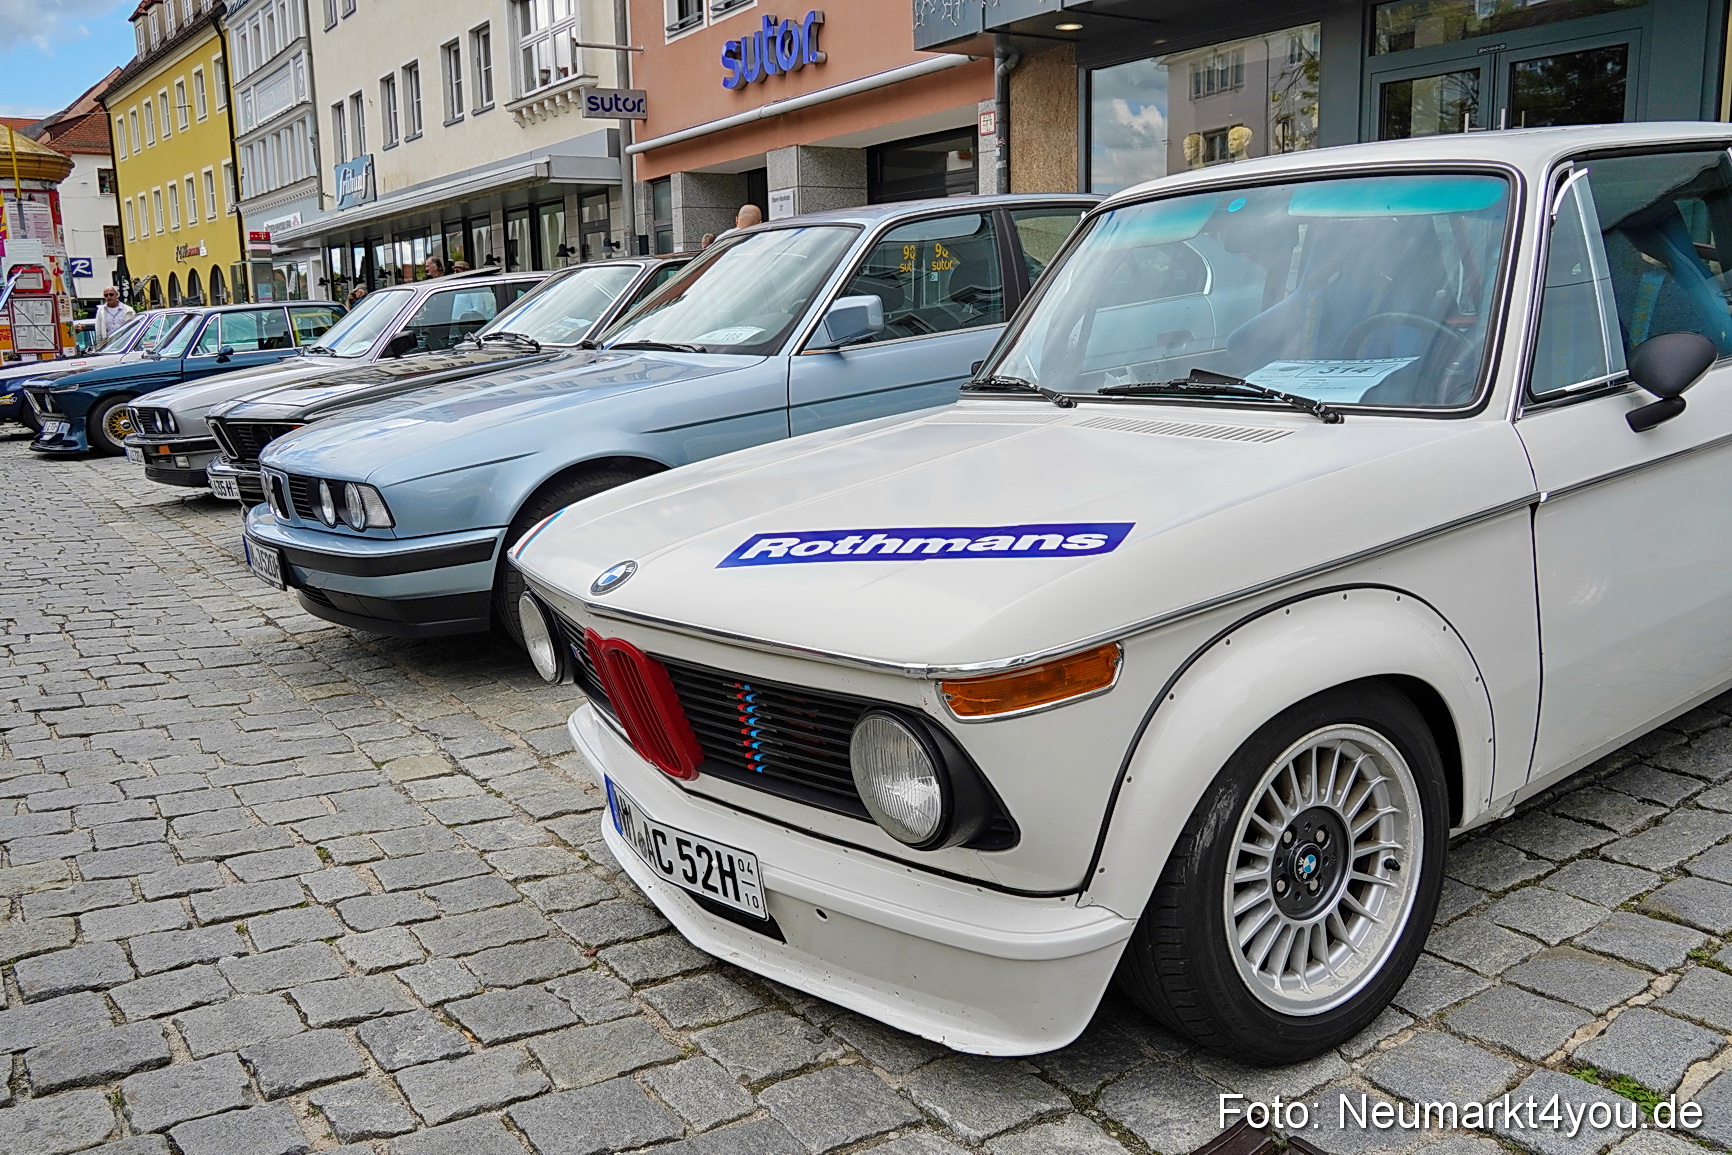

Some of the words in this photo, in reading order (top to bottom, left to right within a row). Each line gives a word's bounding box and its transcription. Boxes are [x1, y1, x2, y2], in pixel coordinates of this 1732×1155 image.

[721, 10, 827, 90] sutor.
[587, 93, 646, 114] sutor.
[1318, 366, 1374, 374] 314
[738, 530, 1108, 561] Rothmans
[643, 820, 674, 875] AC
[675, 837, 741, 903] 52H
[737, 857, 754, 876] 04
[744, 892, 759, 909] 10
